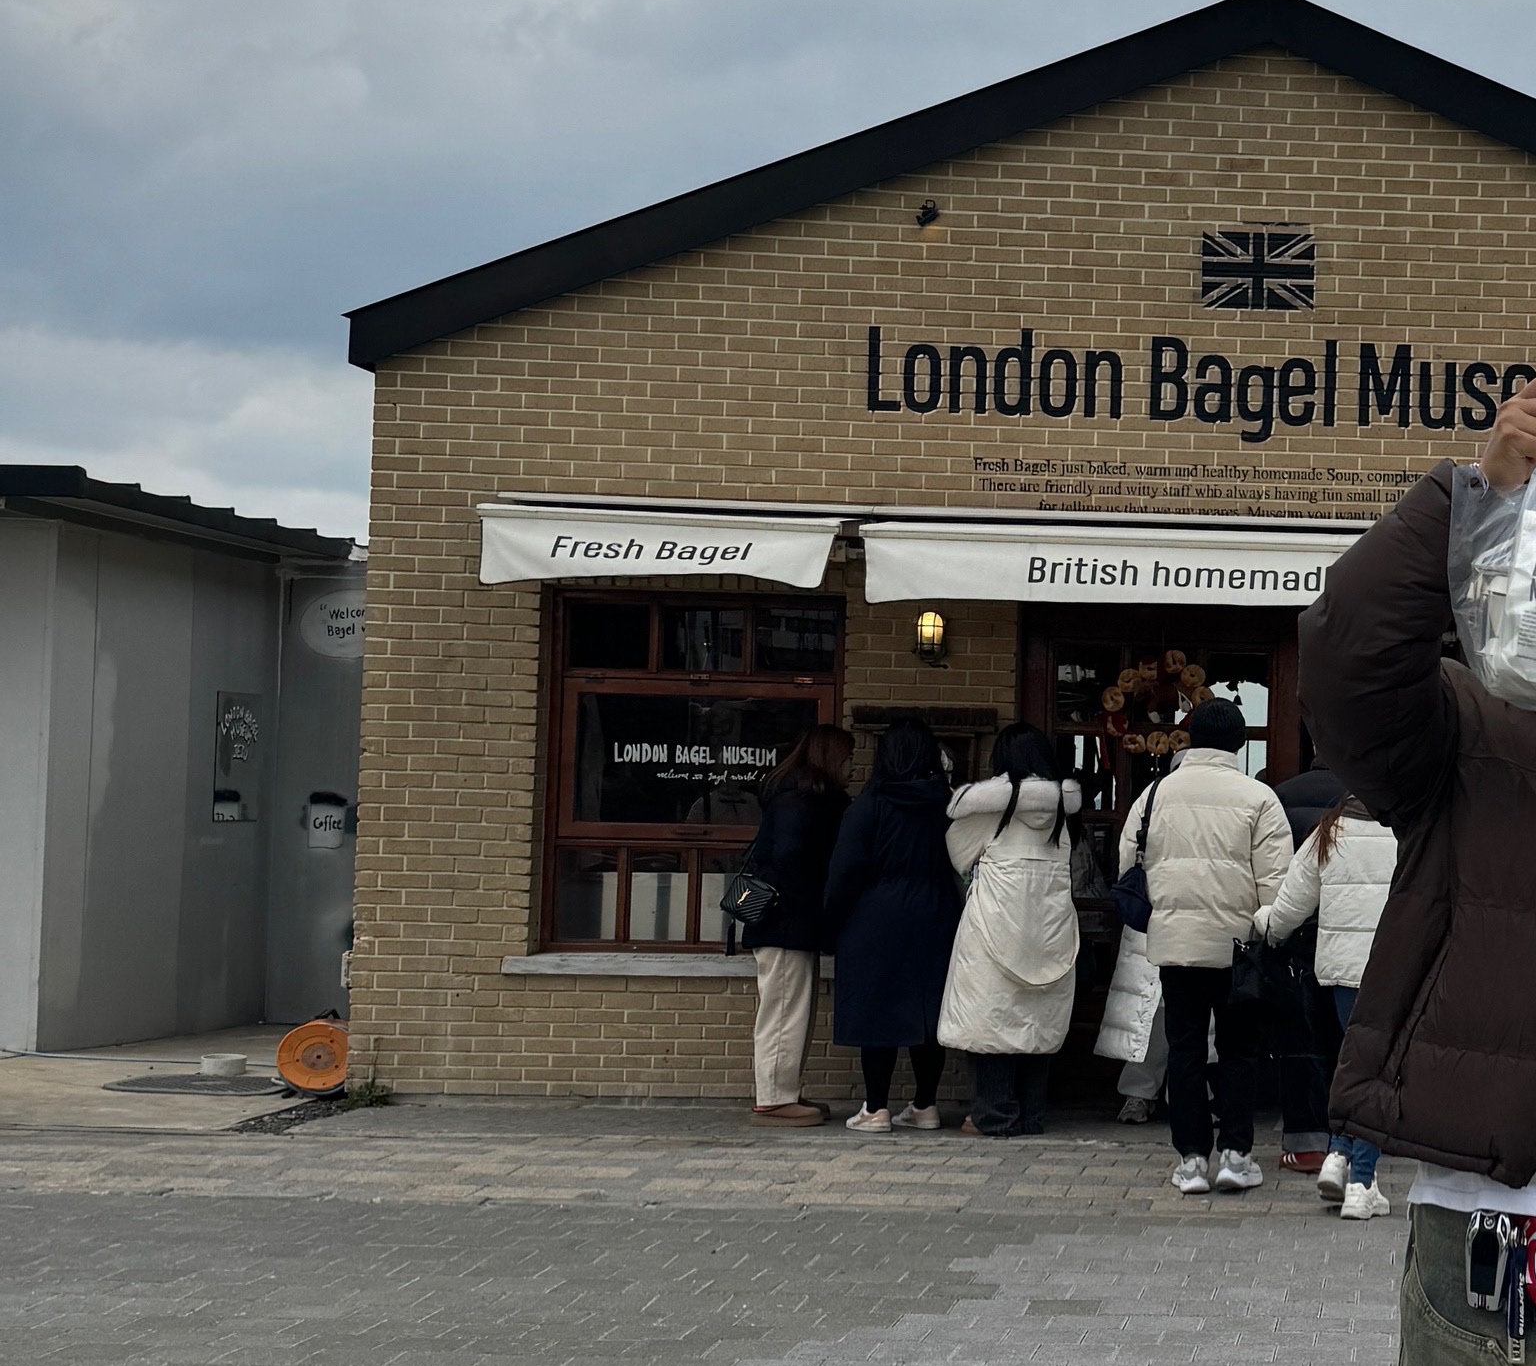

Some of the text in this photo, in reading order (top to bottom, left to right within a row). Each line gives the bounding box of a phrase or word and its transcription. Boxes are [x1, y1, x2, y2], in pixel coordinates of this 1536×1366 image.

[867, 326, 1123, 420] London
[1149, 335, 1337, 442] Bagel
[974, 457, 1009, 472] Fresh
[1014, 458, 1057, 476] Bagels
[1060, 460, 1084, 476] just
[1087, 460, 1130, 477] baked,
[1135, 464, 1170, 478] warm
[1175, 465, 1198, 478] and
[1202, 465, 1248, 482] healthy
[1253, 466, 1323, 481] homemade
[1327, 468, 1363, 484] Soup,
[979, 478, 1016, 492] There
[1020, 482, 1040, 492] are
[1044, 480, 1094, 497] friendly
[1099, 483, 1122, 495] and
[1126, 483, 1158, 498] witty
[1162, 483, 1191, 497] staff
[1195, 485, 1223, 498] who
[1226, 487, 1270, 502] always
[1275, 488, 1318, 503] having
[1322, 488, 1343, 501] fun
[1347, 489, 1381, 502] small
[550, 536, 753, 565] Fresh Bagel
[1027, 556, 1322, 592] British homemad
[327, 623, 355, 639] Bagel
[614, 742, 777, 766] LONDON BAGEL MUSEUM
[313, 815, 343, 831] Coffee
